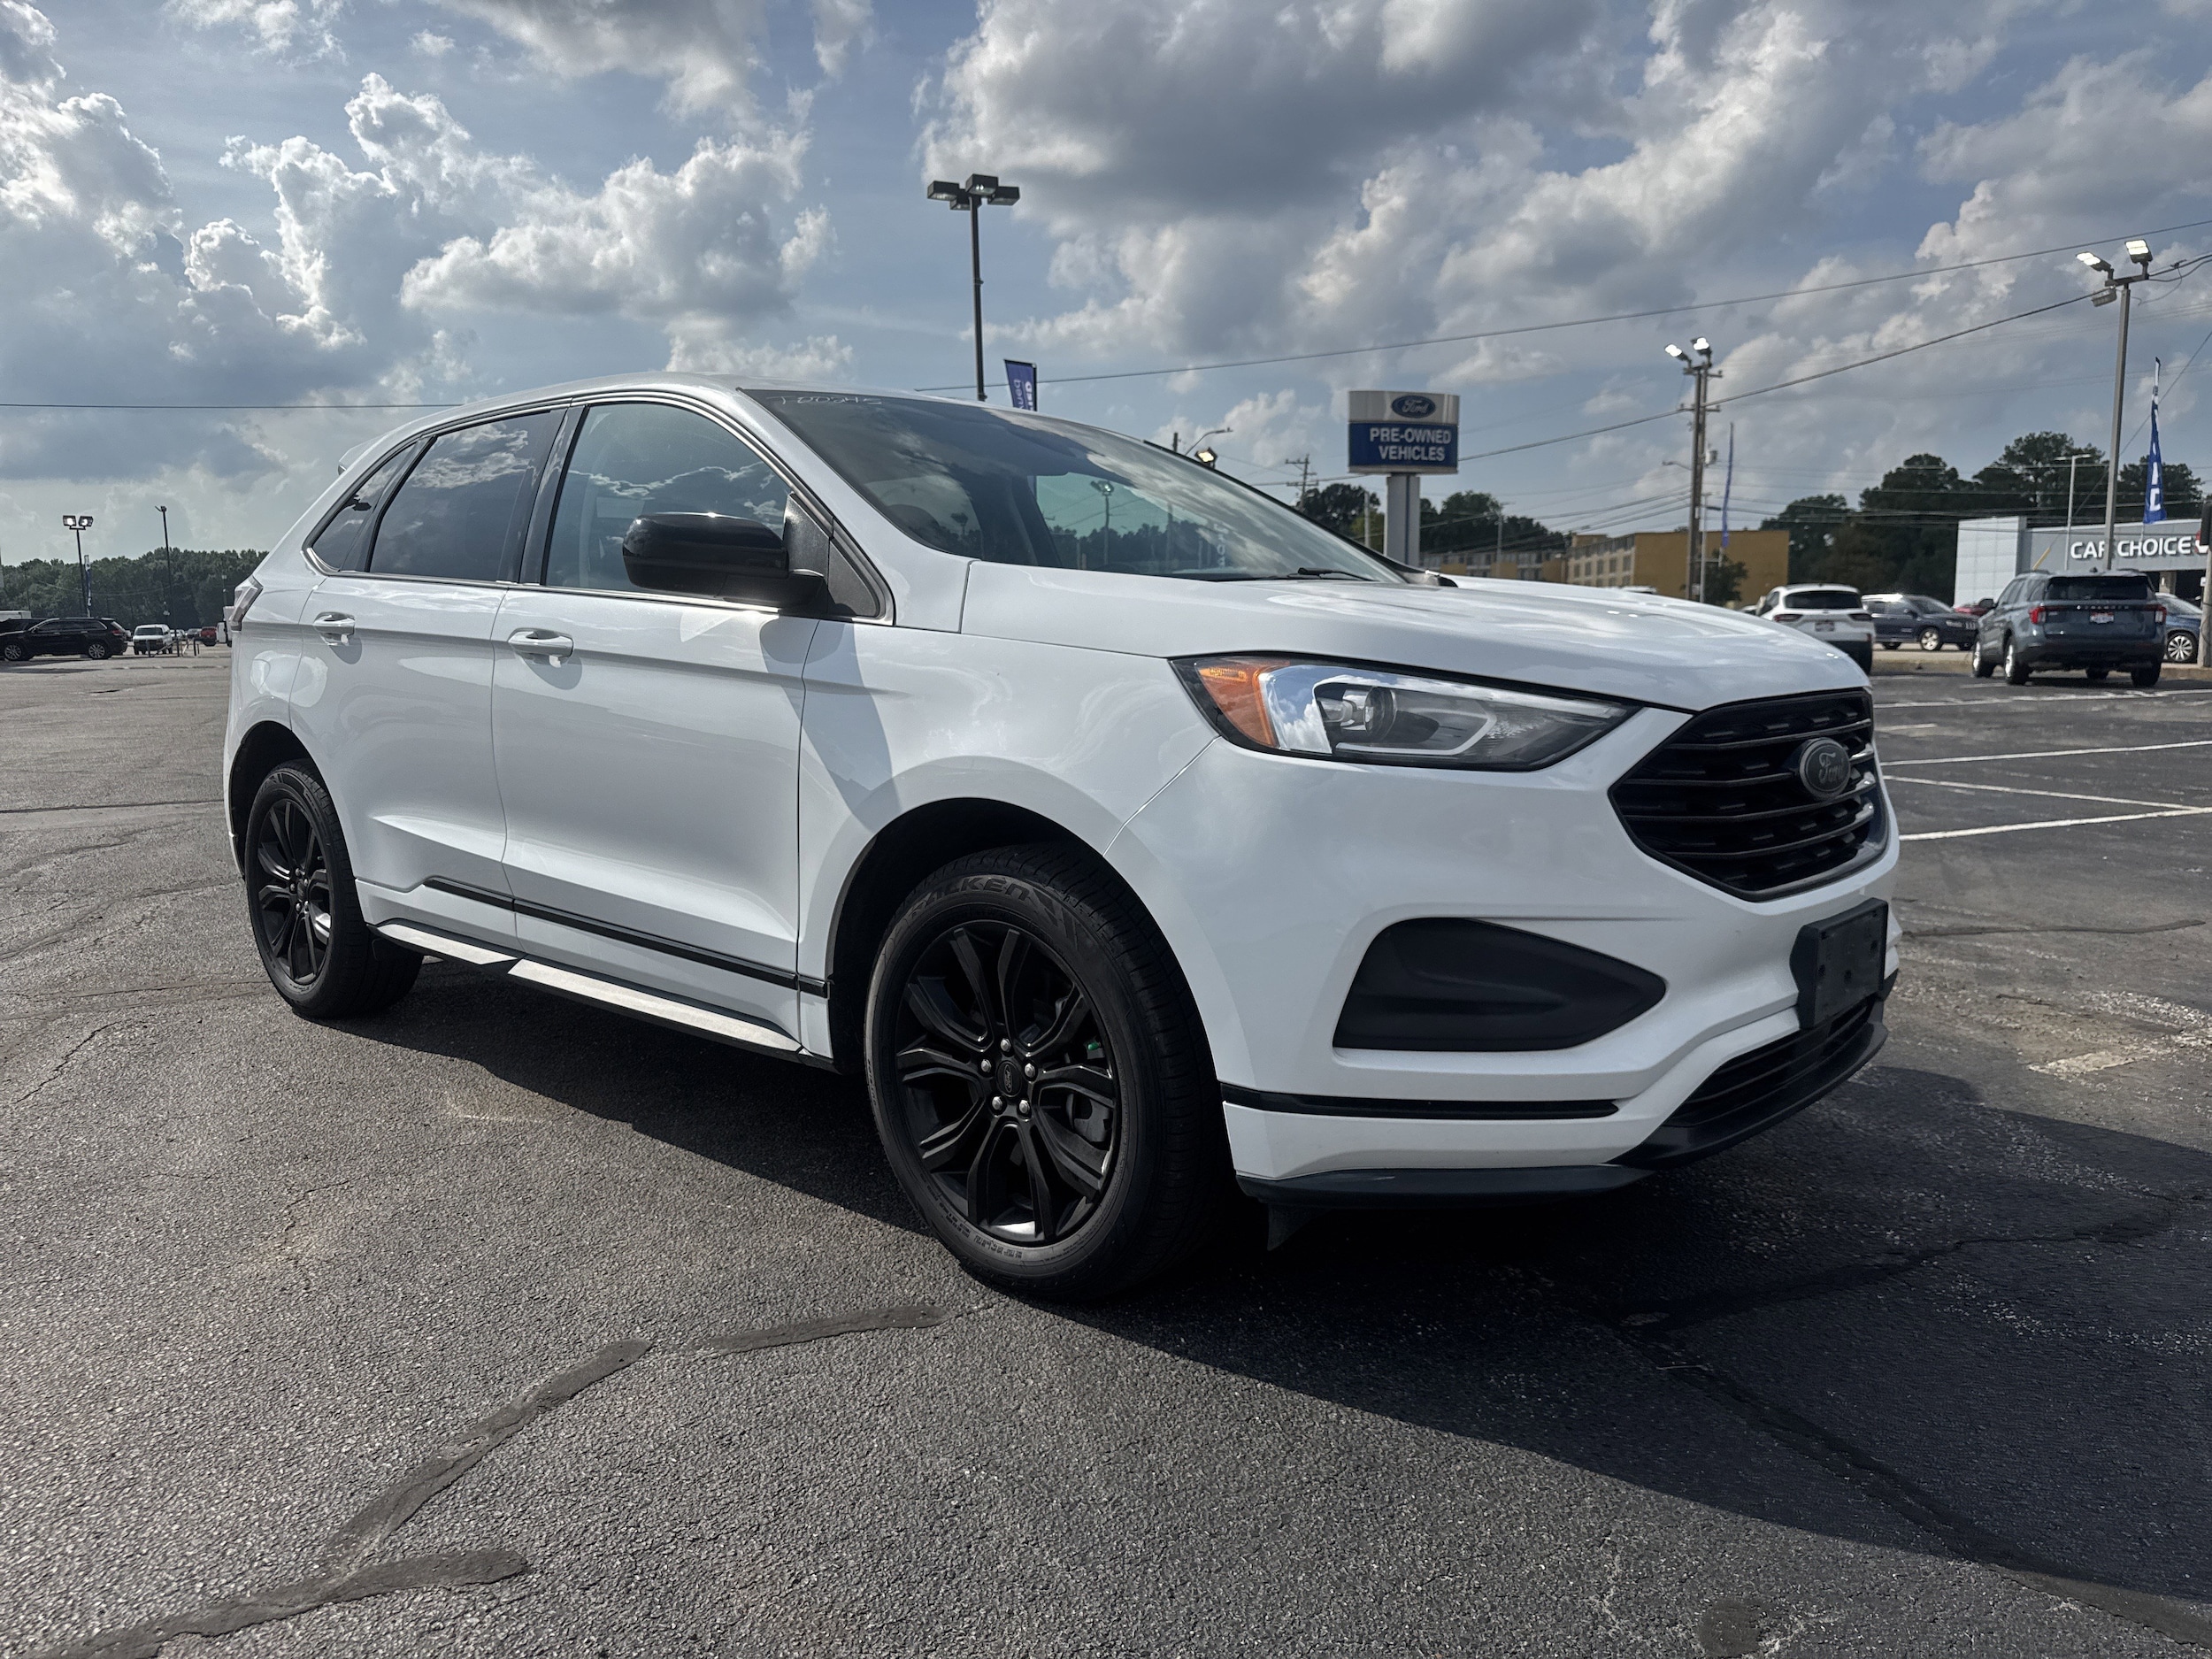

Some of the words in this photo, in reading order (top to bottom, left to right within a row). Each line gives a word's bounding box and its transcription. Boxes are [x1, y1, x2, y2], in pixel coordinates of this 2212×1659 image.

[1401, 398, 1429, 414] Ford
[1369, 427, 1452, 444] PRE-OWNED
[1378, 445, 1446, 462] VEHICLES
[2116, 535, 2193, 557] CHOICE
